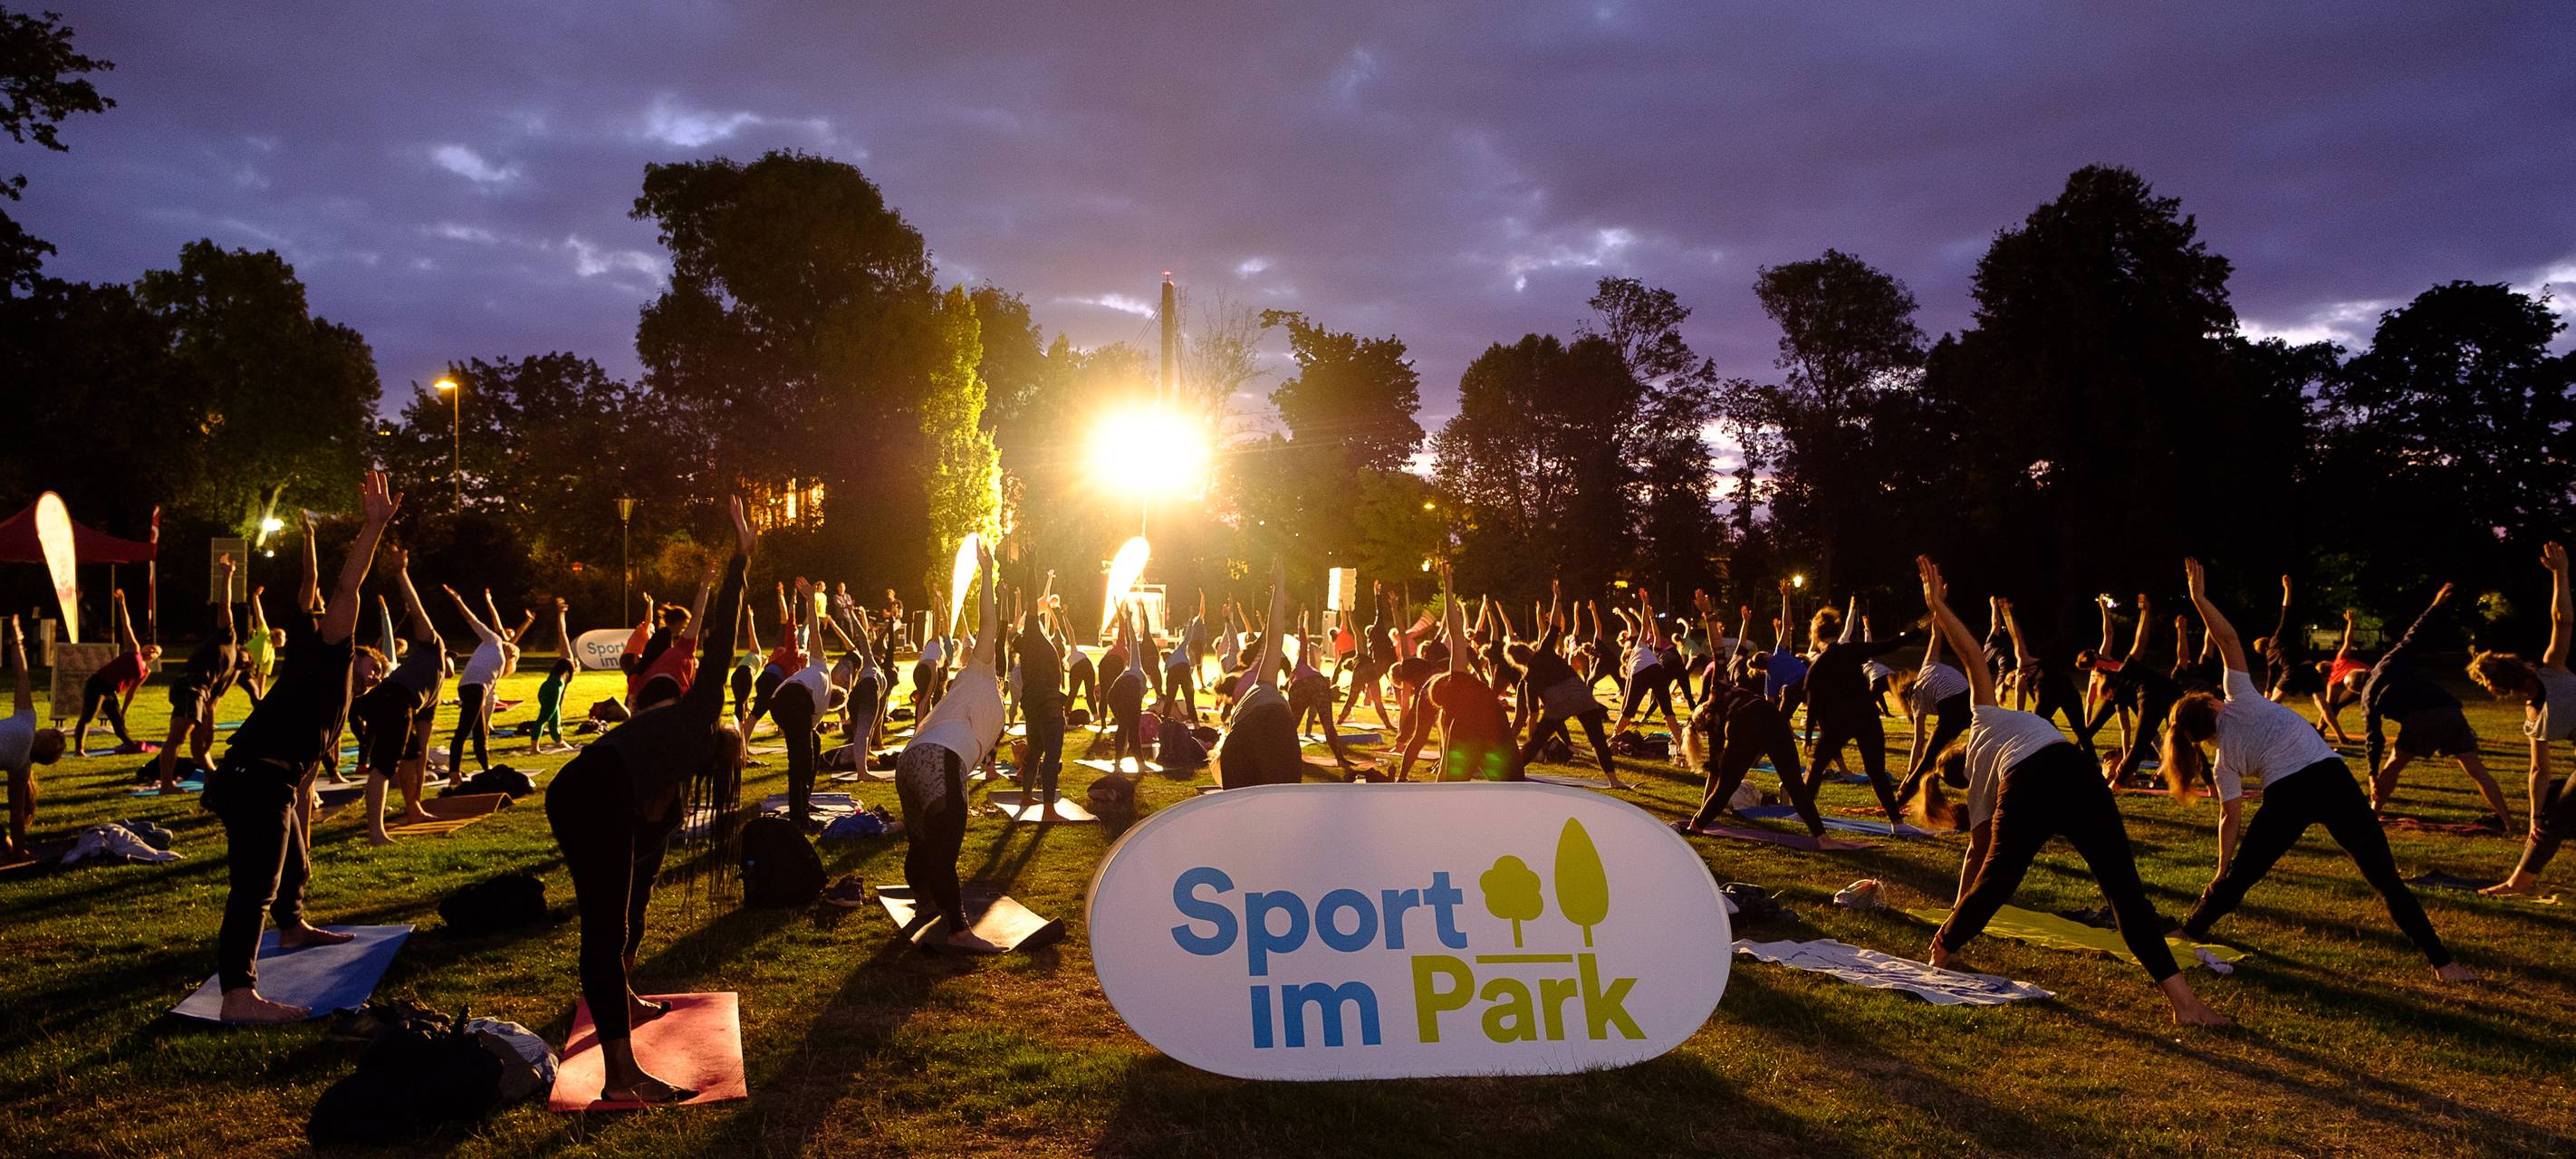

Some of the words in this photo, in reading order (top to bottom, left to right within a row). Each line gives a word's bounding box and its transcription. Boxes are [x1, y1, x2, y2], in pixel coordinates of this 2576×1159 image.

[601, 657, 619, 667] im
[1171, 867, 1468, 976] Sport
[1250, 981, 1381, 1049] im
[1411, 953, 1647, 1043] Park
